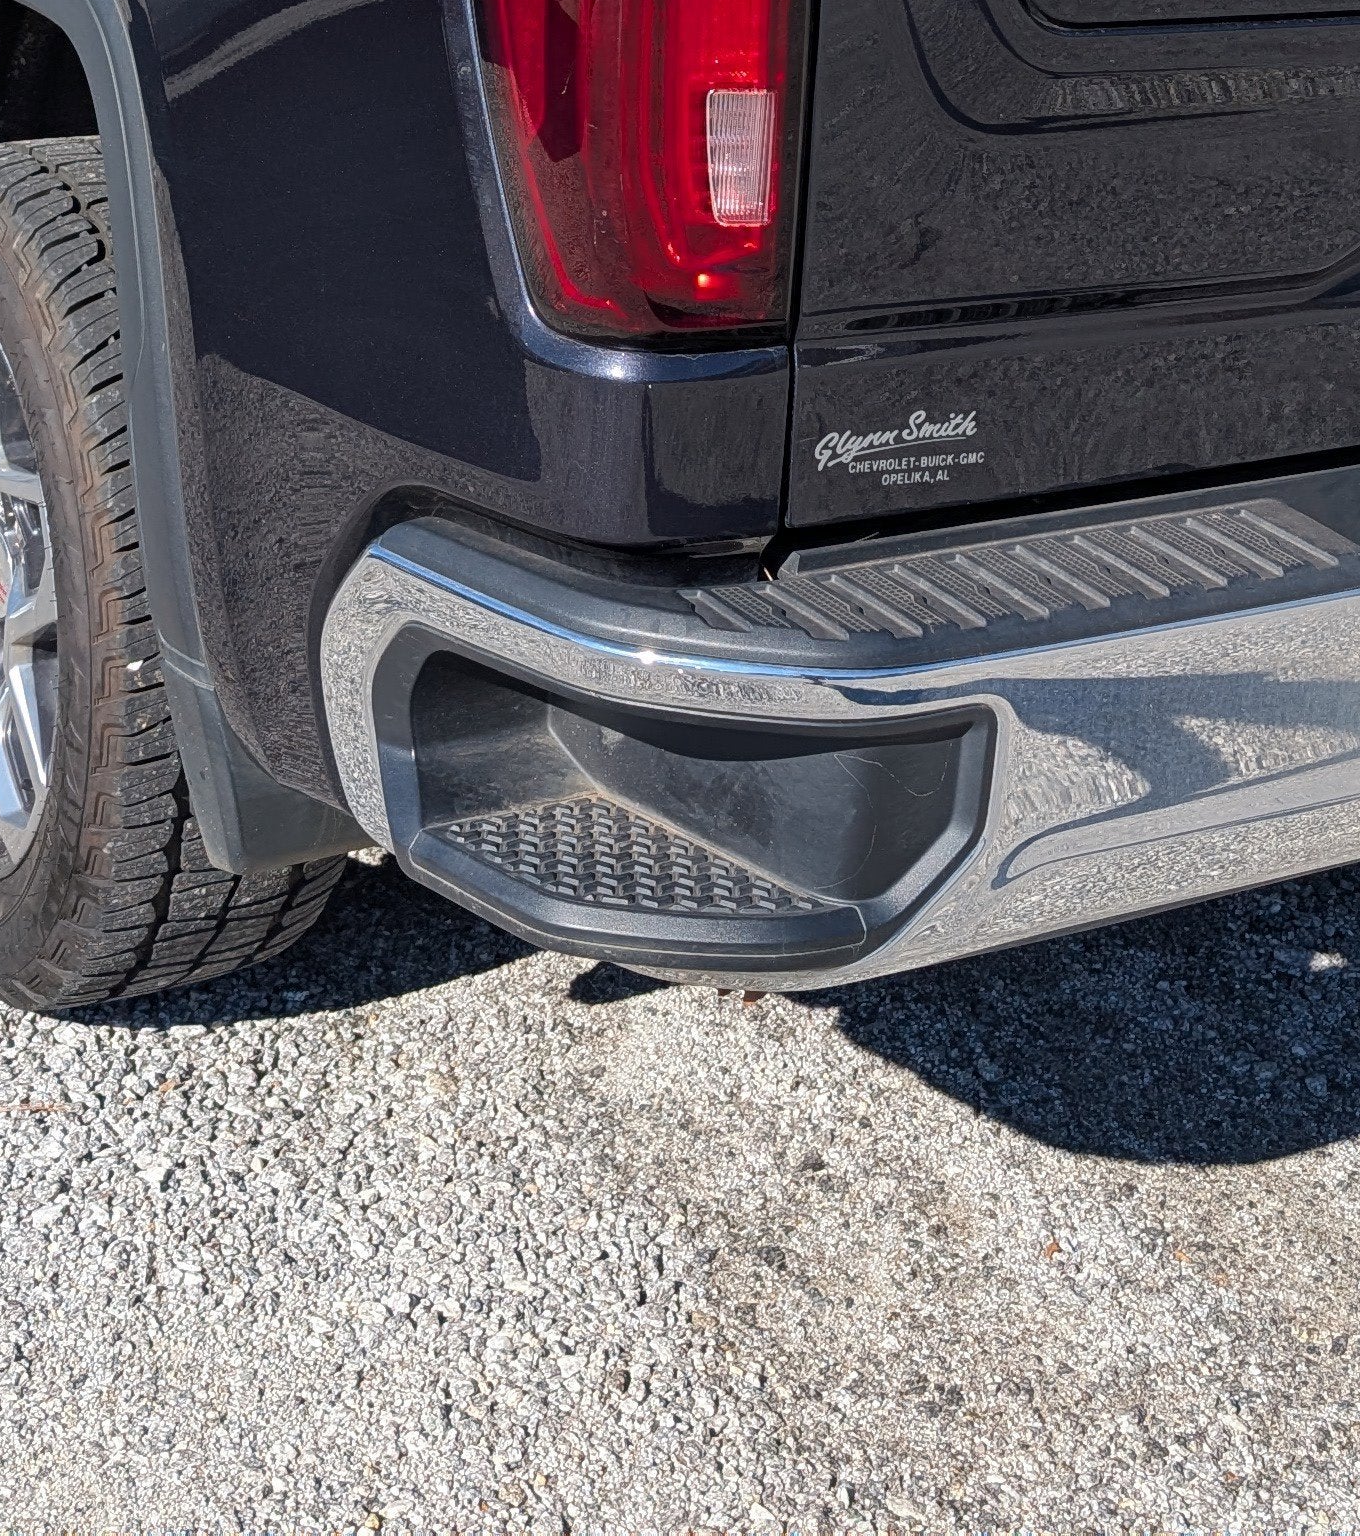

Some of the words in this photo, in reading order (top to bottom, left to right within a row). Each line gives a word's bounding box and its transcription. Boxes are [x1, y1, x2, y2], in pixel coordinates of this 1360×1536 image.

[814, 429, 898, 471] Glynn
[901, 410, 978, 440] Smith
[848, 451, 985, 474] CHEVROLET-BUICK-GMC
[881, 471, 934, 486] OPELIKA,
[935, 470, 950, 482] AL
